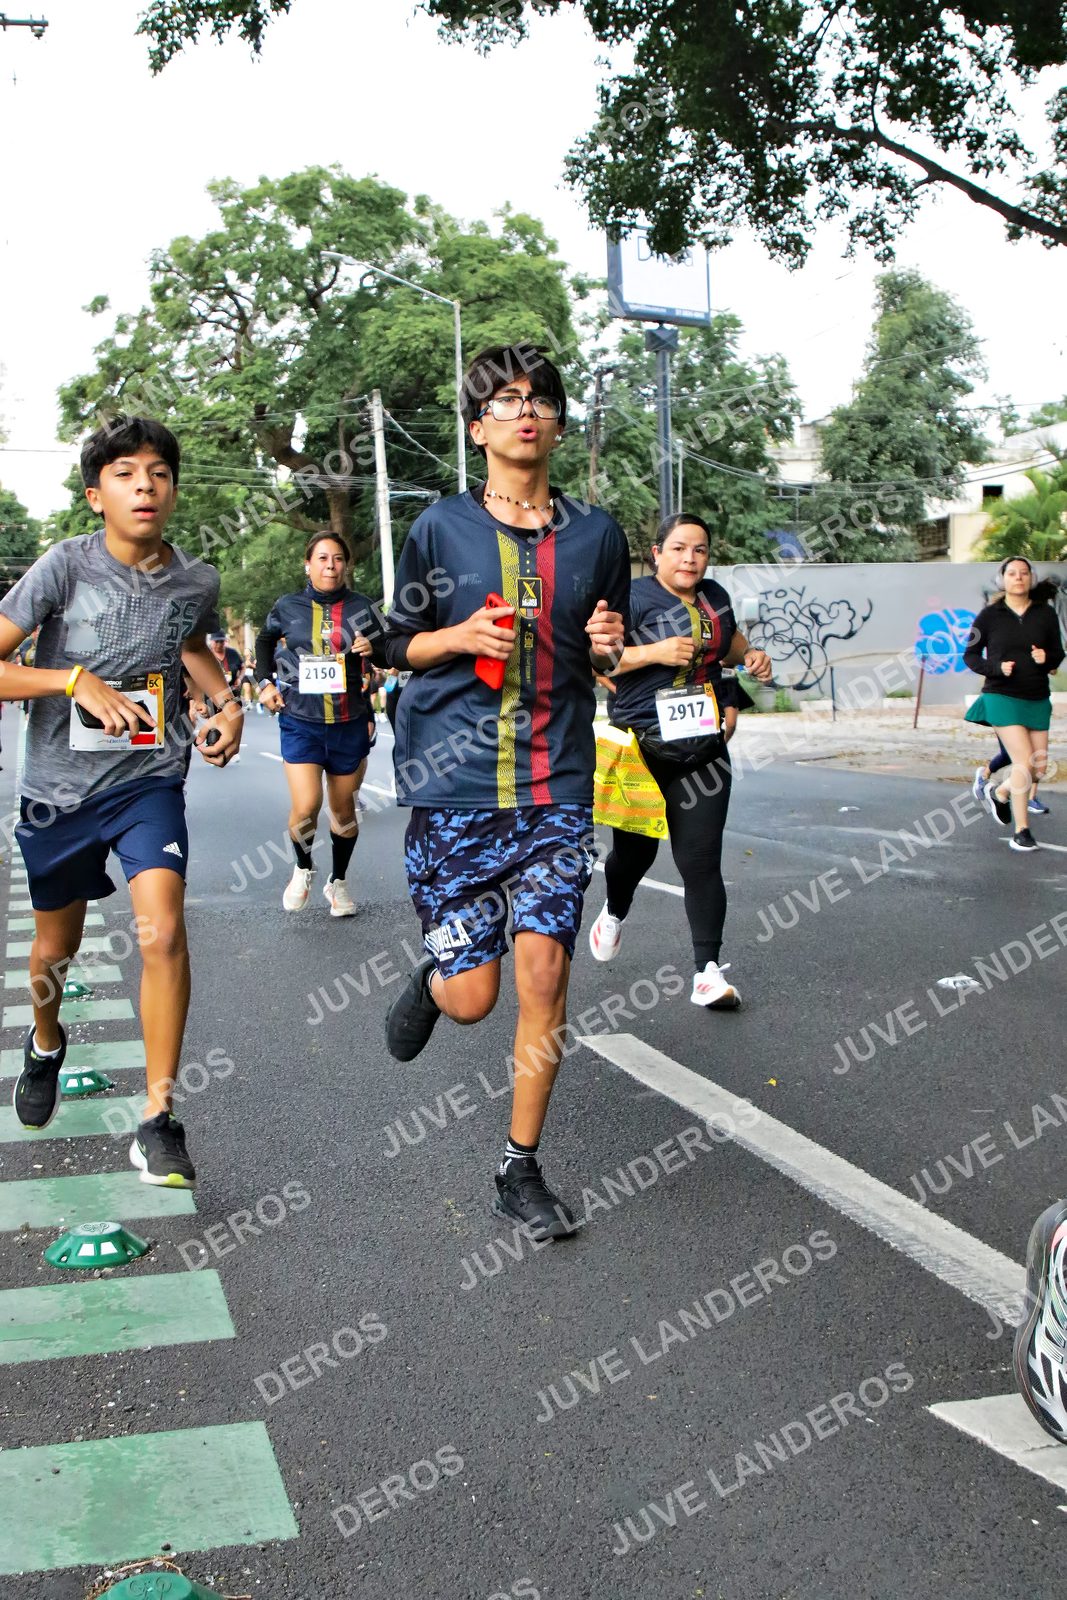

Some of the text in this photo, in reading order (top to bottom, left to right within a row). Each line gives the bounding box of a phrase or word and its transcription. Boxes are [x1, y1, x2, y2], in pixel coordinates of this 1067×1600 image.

[305, 667, 336, 680] 2150
[149, 679, 159, 688] 5K
[667, 700, 705, 722] 2917
